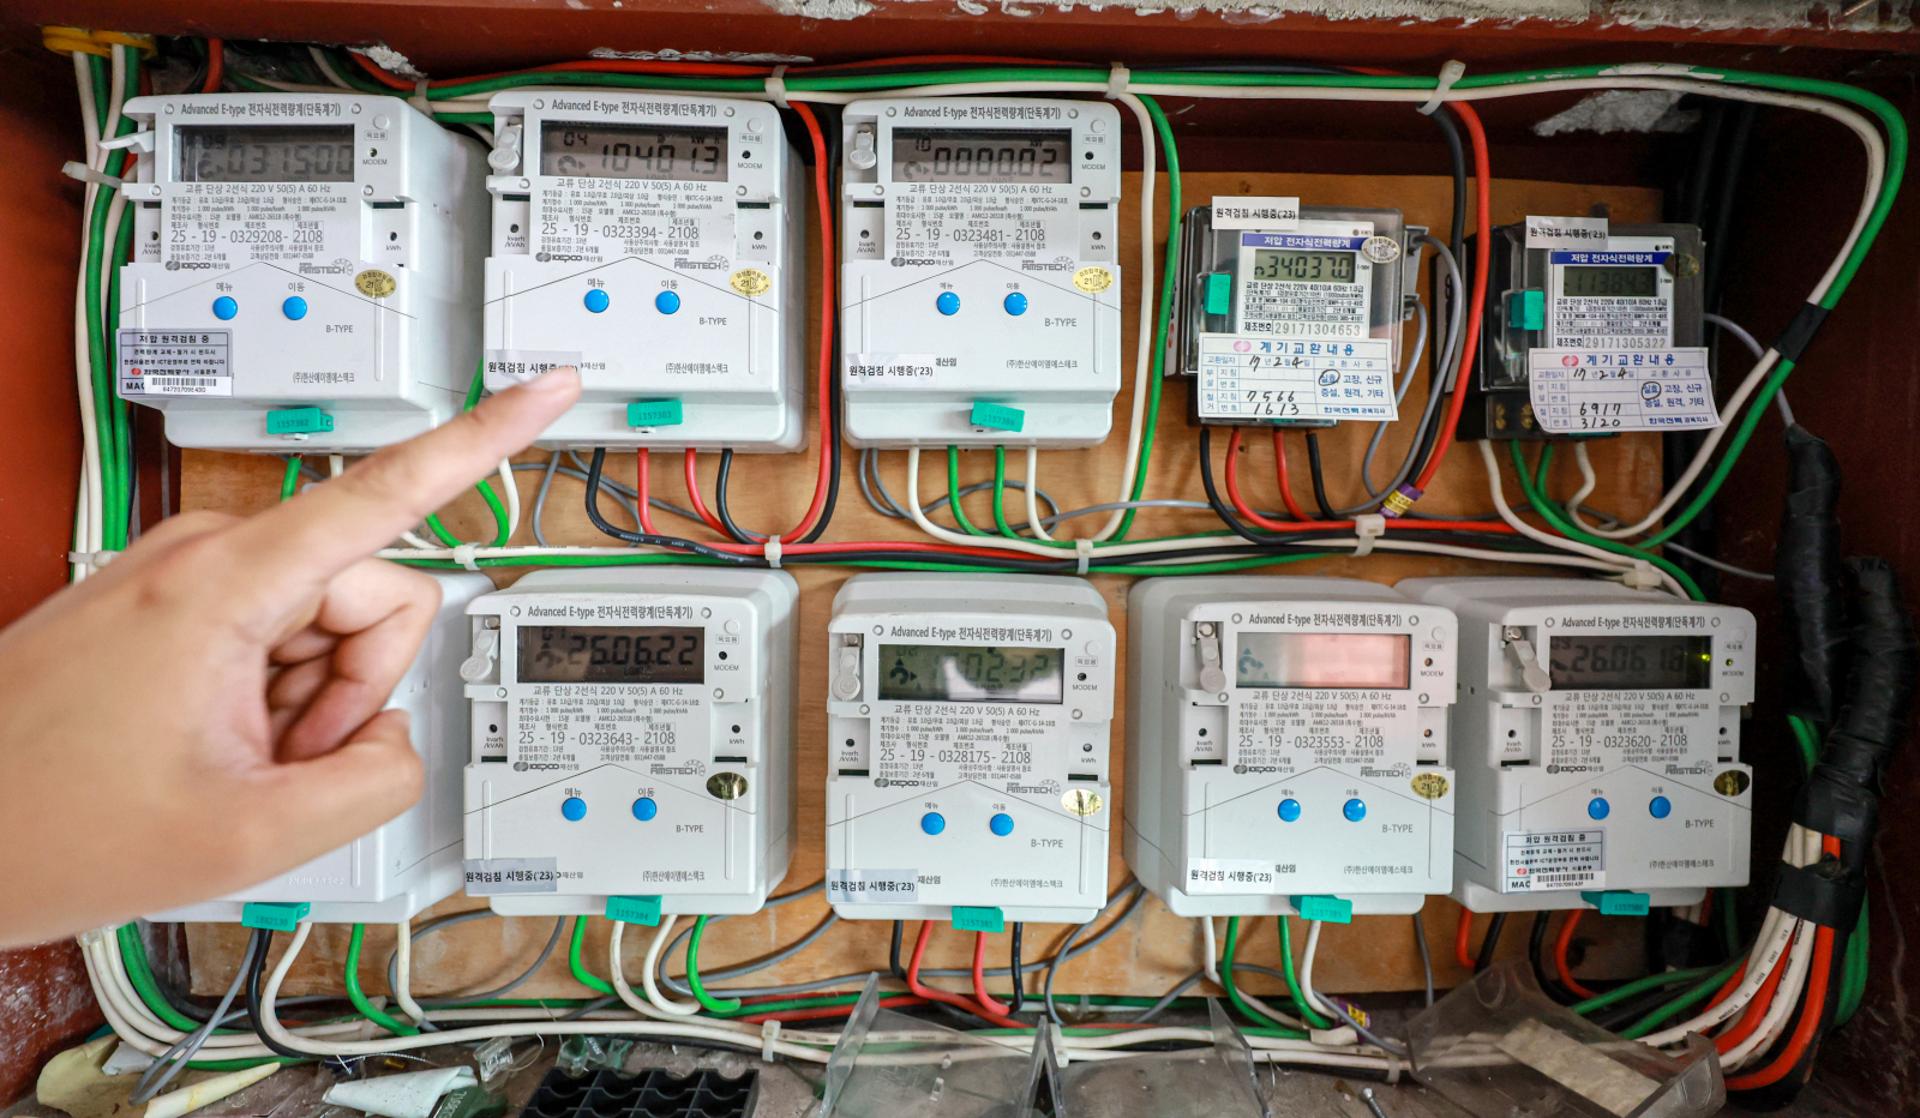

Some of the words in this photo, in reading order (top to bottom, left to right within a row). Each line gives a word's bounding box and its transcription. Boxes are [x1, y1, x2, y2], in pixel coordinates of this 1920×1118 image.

[181, 103, 219, 114] Advanced
[221, 103, 246, 117] E-type
[552, 99, 591, 111] Advanced
[593, 100, 619, 114] E-type
[621, 101, 717, 117] 전자식전력량계(단독계기)
[904, 106, 941, 117] Advanced
[943, 106, 968, 120] E-type
[970, 106, 1061, 119] 전자식전력량계(단독계기)
[250, 184, 266, 193] 220
[307, 184, 318, 193] 60
[556, 179, 575, 188] 교류
[578, 179, 596, 189] 단상
[598, 180, 621, 189] 2선식
[624, 180, 640, 190] 220
[651, 181, 672, 191] 50(5)
[683, 182, 694, 191] 60
[696, 183, 707, 192] Hz
[909, 184, 926, 194] 교류
[929, 184, 946, 194] 단상
[949, 184, 970, 195] 2선식
[973, 184, 988, 193] 220
[999, 184, 1018, 194] 50(5)
[1029, 185, 1040, 194] 60
[1042, 186, 1052, 194] Hz
[1215, 207, 1249, 219] 원격검침
[171, 230, 186, 243] 25
[202, 230, 217, 243] 19
[293, 230, 324, 243] 2108
[541, 223, 557, 235] 25
[574, 224, 588, 236] 19
[668, 225, 700, 240] 2108
[896, 228, 911, 240] 25
[926, 228, 940, 240] 19
[1015, 228, 1045, 242] 2108
[1264, 236, 1283, 245] 저압
[1286, 236, 1350, 248] 전자식전력량계
[1571, 254, 1589, 262] 저압
[1592, 254, 1653, 263] 전자식전력량계
[699, 317, 727, 326] B-TYPE
[1044, 317, 1077, 327] B-TYPE
[1244, 322, 1272, 332] 제조번호
[326, 324, 352, 333] B-TYPE
[1275, 322, 1361, 337] 29171304653
[1556, 337, 1583, 347] 제조번호
[488, 362, 526, 374] 원격검침
[849, 365, 884, 377] 원격검침
[1366, 375, 1383, 385] 신규
[1368, 389, 1384, 398] 기타
[528, 605, 567, 617] Advanced
[569, 606, 595, 620] E-type
[597, 605, 693, 619] 전자식전력량계(단독계기)
[1249, 613, 1285, 624] Advanced
[1287, 613, 1311, 627] E-type
[1313, 613, 1402, 627] 전자식전력량계(단독계기)
[1562, 616, 1596, 627] Advanced
[1598, 616, 1620, 630] E-type
[890, 625, 929, 637] Advanced
[931, 626, 956, 640] E-type
[958, 627, 1052, 642] 전자식전력량계(단독계기)
[533, 686, 551, 696] 교류
[554, 686, 572, 696] 단상
[574, 686, 597, 696] 2선식
[600, 686, 616, 695] 220
[627, 686, 648, 696] 50(5)
[659, 686, 670, 695] 60
[672, 687, 683, 696] Hz
[1252, 690, 1268, 700] 교류
[1272, 691, 1288, 701] 단상
[1291, 691, 1312, 701] 2선식
[1315, 691, 1330, 700] 220
[1340, 692, 1359, 702] 50(5)
[1369, 692, 1379, 700] 60
[1381, 692, 1391, 700] Hz
[894, 704, 912, 715] 교류
[915, 704, 932, 715] 단상
[935, 705, 957, 716] 2선식
[959, 706, 975, 715] 220
[985, 706, 1005, 716] 50(5)
[1016, 707, 1027, 716] 60
[1029, 708, 1040, 716] Hz
[519, 731, 534, 744] 25
[550, 732, 565, 744] 19
[644, 732, 676, 745] 2108
[1239, 735, 1253, 747] 25
[1268, 735, 1282, 748] 19
[1355, 736, 1384, 748] 2108
[1552, 736, 1565, 748] 25
[1579, 736, 1592, 747] 19
[1660, 735, 1688, 747] 2108
[880, 749, 895, 761] 25
[910, 750, 925, 762] 19
[1001, 750, 1032, 765] 2108
[676, 824, 703, 833] B-TYPE
[1382, 824, 1413, 833] B-TYPE
[1685, 819, 1714, 828] B-TYPE
[1031, 838, 1063, 848] B-TYPE
[465, 871, 502, 882] 원격검침
[1190, 870, 1225, 881] 원격검침
[831, 881, 866, 892] 원격검침
